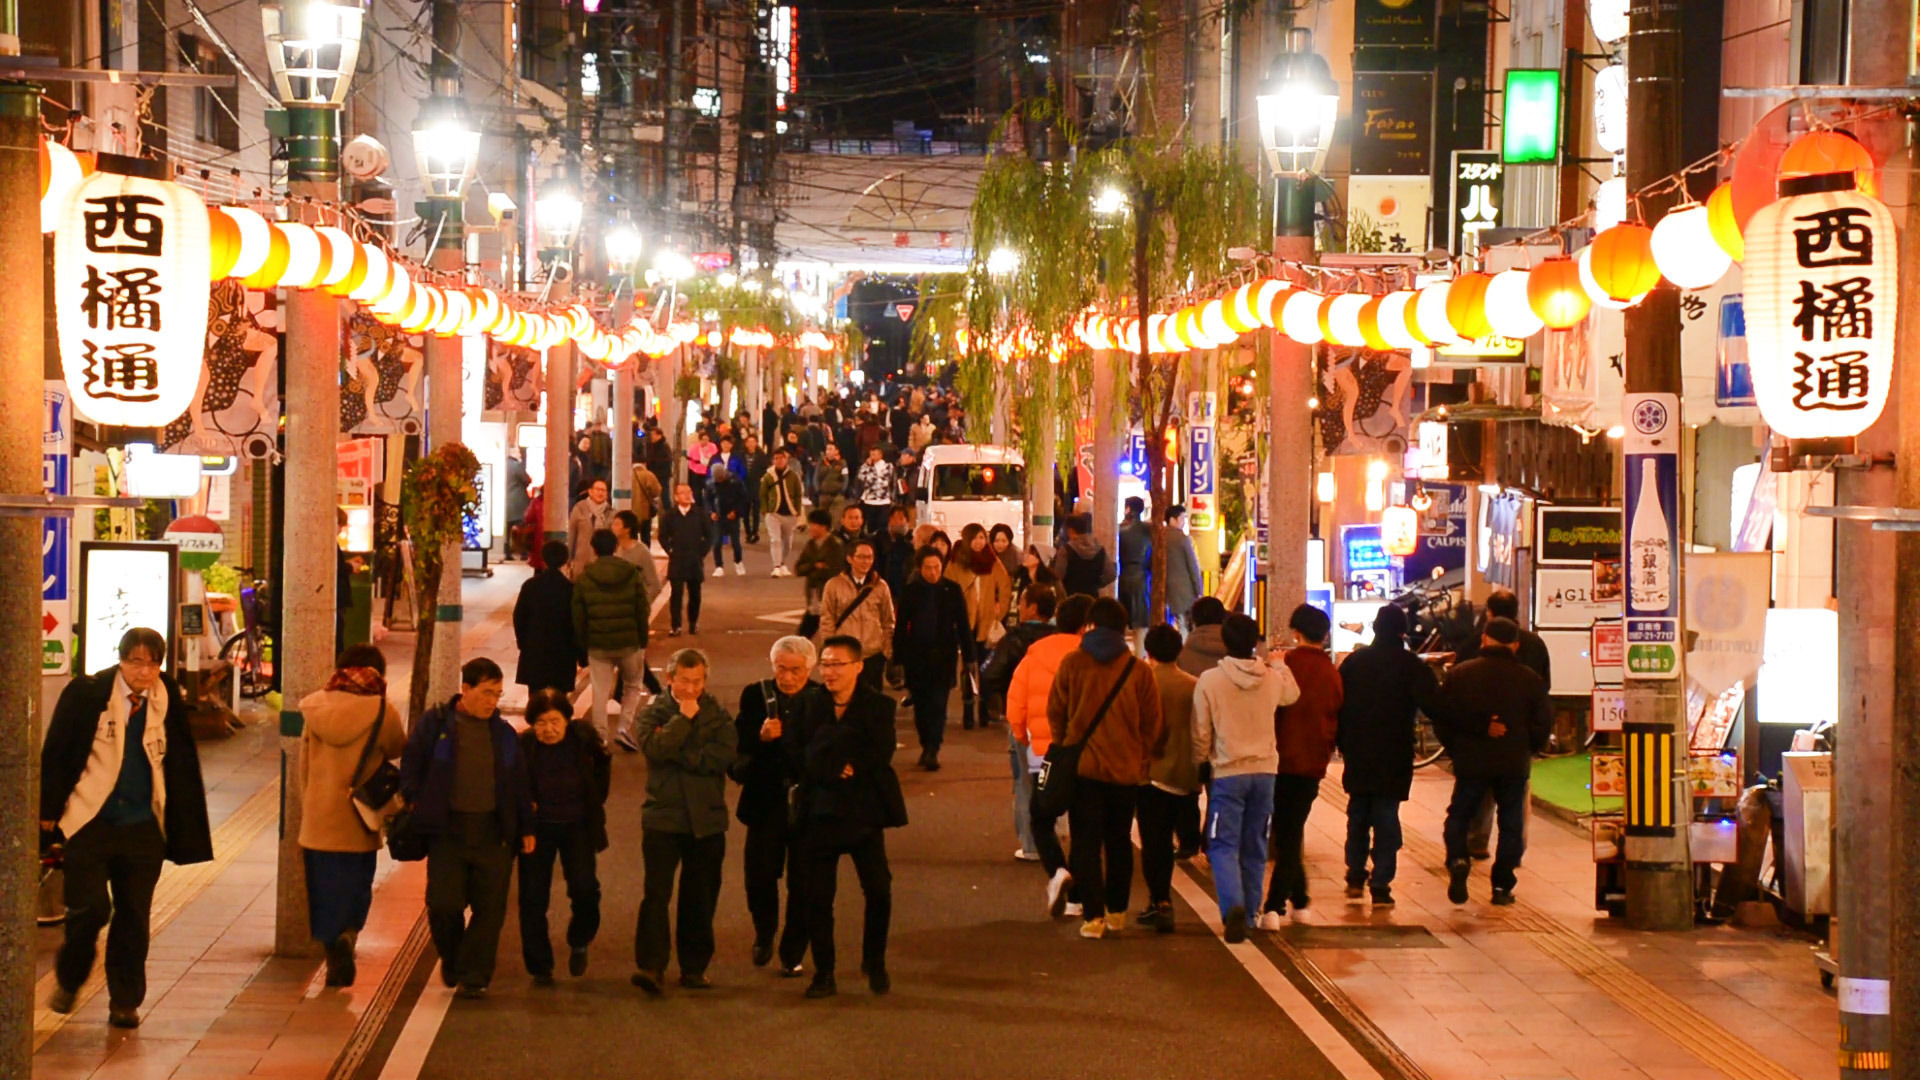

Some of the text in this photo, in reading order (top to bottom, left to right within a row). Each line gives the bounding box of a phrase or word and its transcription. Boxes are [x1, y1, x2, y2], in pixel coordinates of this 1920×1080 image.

[1459, 162, 1503, 181] スタンド
[81, 194, 165, 403] 西橘通
[1792, 206, 1875, 411] 西橘通
[1193, 428, 1209, 493] ローソン
